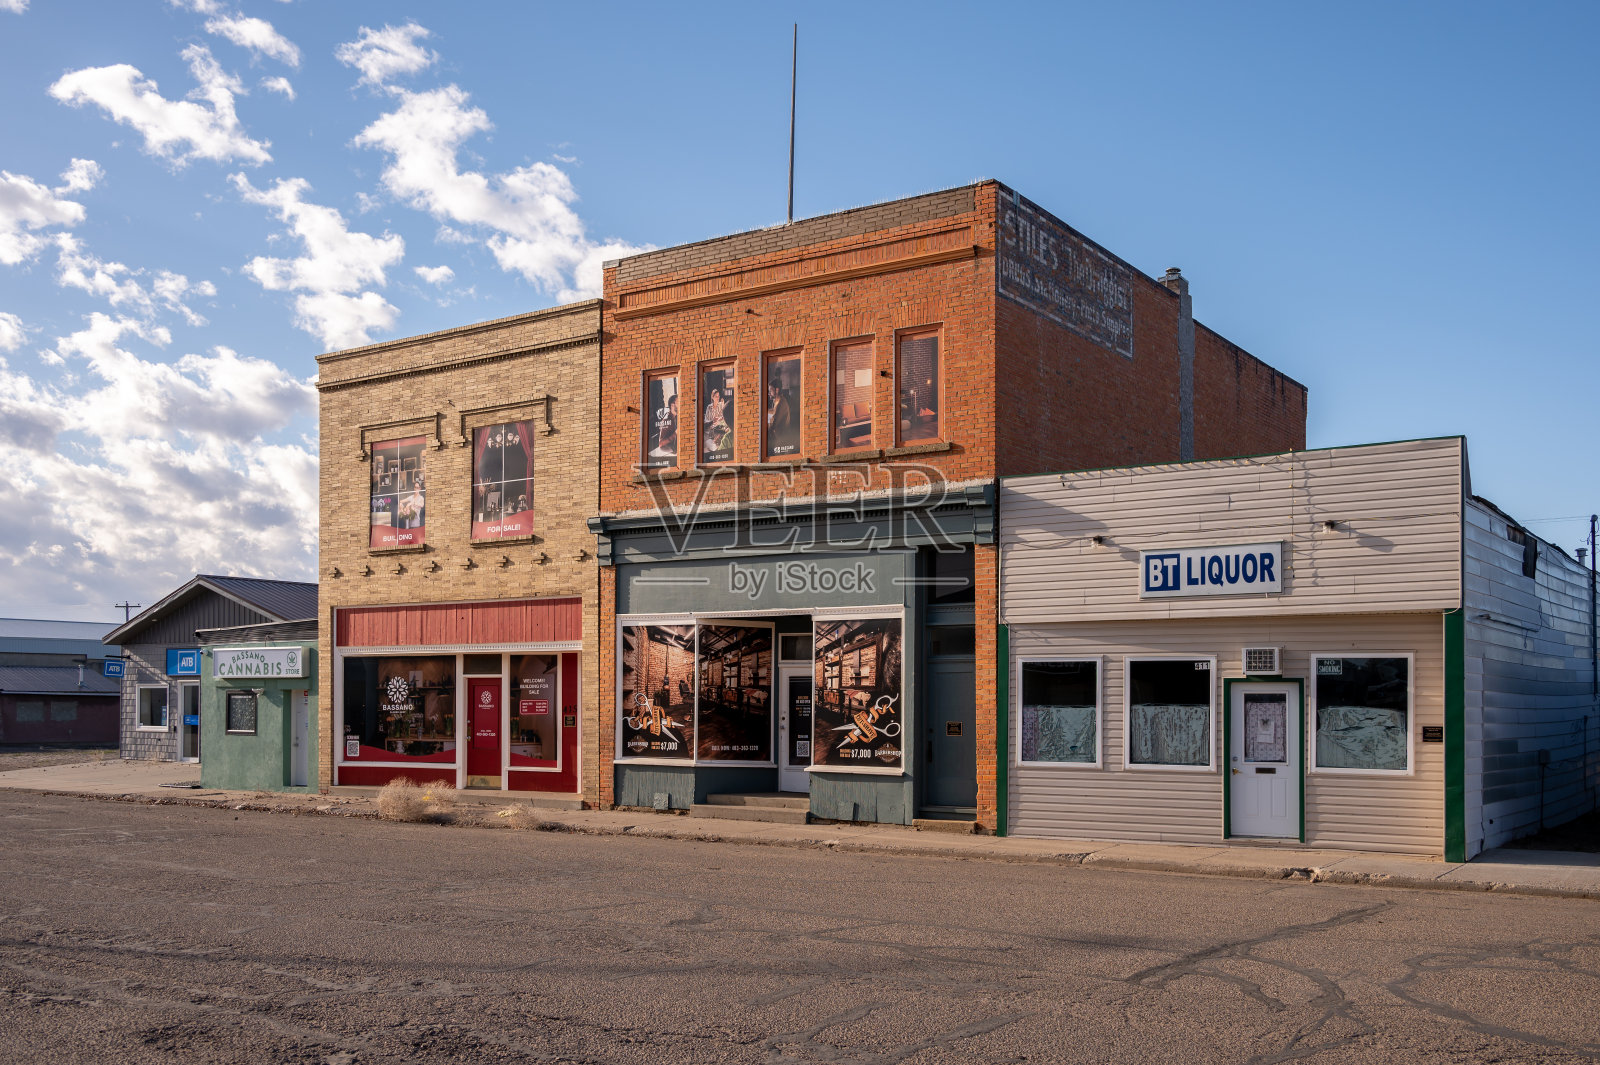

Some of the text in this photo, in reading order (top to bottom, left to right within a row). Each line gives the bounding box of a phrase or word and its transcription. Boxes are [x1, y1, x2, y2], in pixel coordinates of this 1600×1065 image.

[382, 534, 413, 542] BUILDING
[1149, 553, 1276, 588] BT LIQUOR
[181, 657, 194, 667] ATB
[232, 651, 266, 664] BASSANO
[219, 662, 282, 676] CANNABIS
[1318, 665, 1341, 673] SMOKING
[661, 741, 678, 751] $7,000
[851, 749, 872, 759] $7,000
